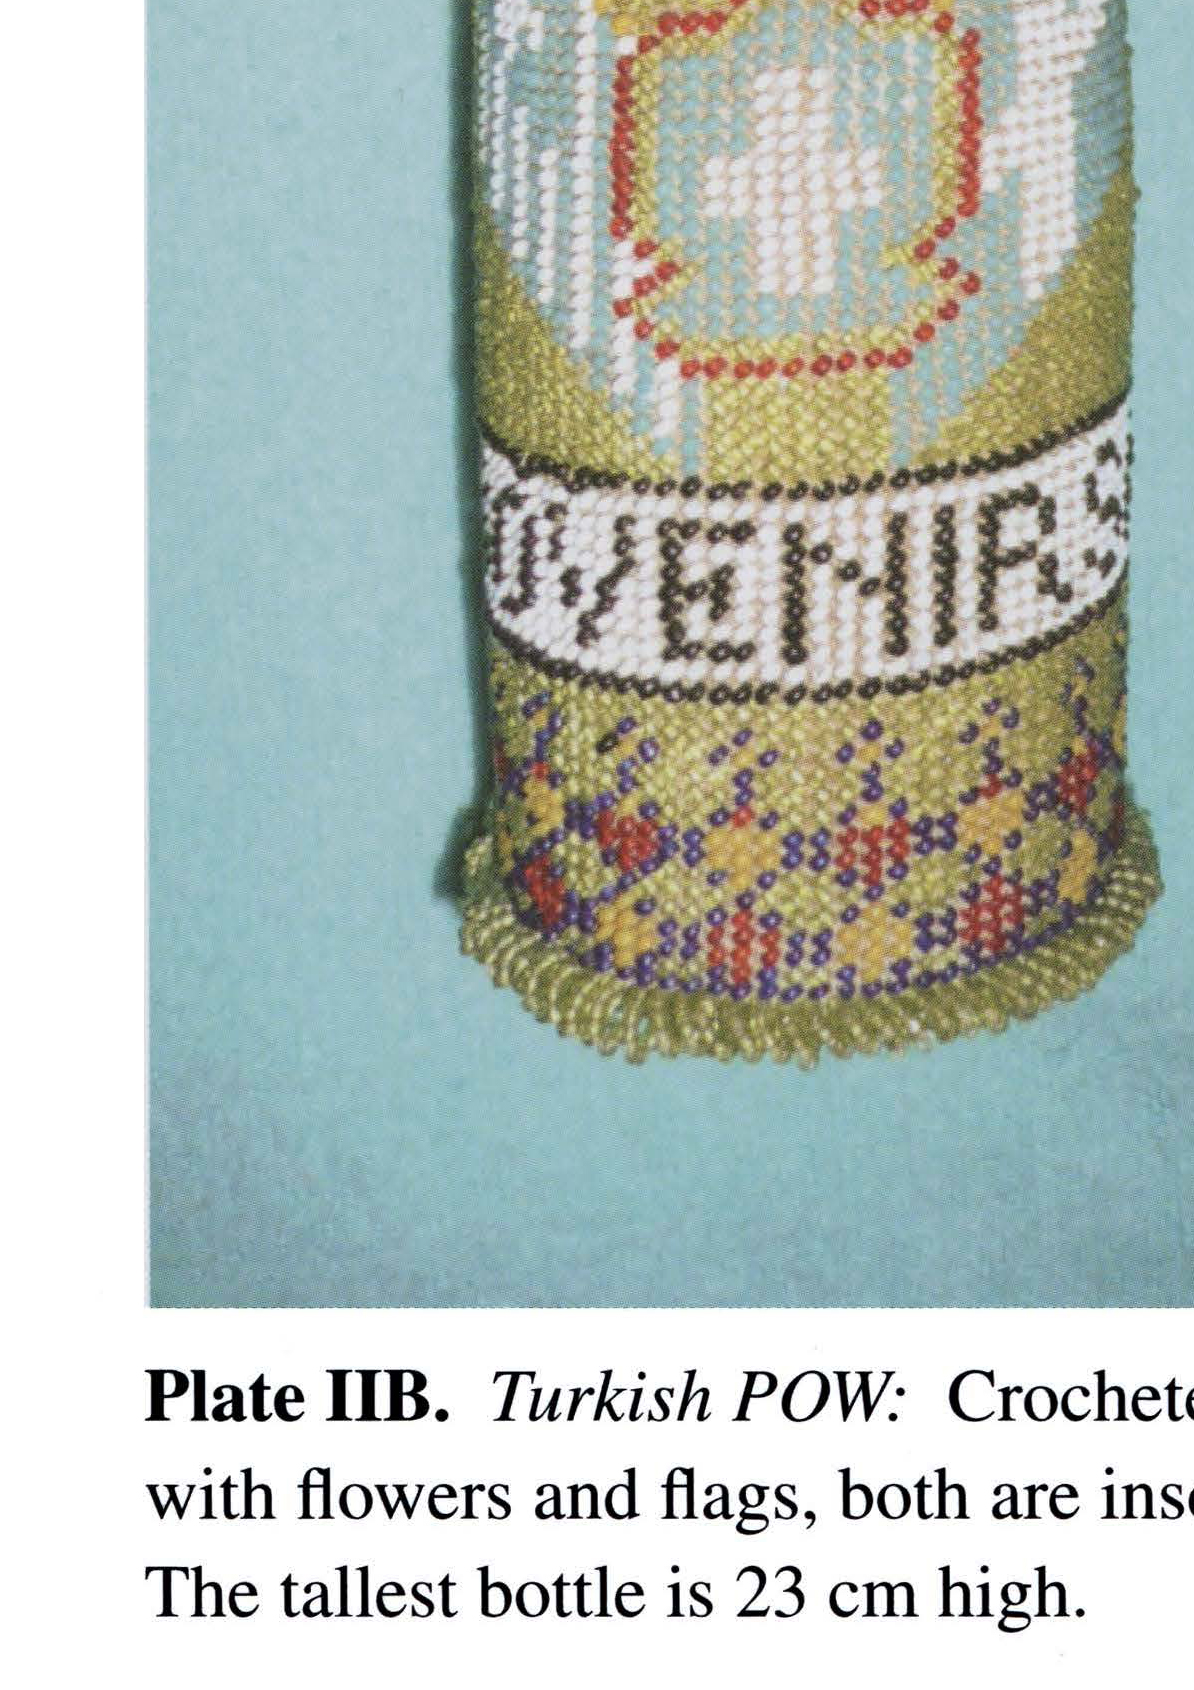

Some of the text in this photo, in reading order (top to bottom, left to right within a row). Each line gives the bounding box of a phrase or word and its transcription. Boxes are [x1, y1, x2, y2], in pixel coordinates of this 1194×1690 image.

[145, 1370, 304, 1422] Plate
[326, 1370, 448, 1422] IIB.
[493, 1369, 711, 1422] Turkish
[732, 1370, 905, 1422] POW:
[146, 1467, 276, 1519] with
[297, 1467, 511, 1520] flowers
[535, 1468, 640, 1520] and
[661, 1467, 816, 1535] flags,
[838, 1467, 970, 1520] both
[992, 1484, 1079, 1519] are
[145, 1565, 1085, 1633] The tallest bottle is 23 cm high.
